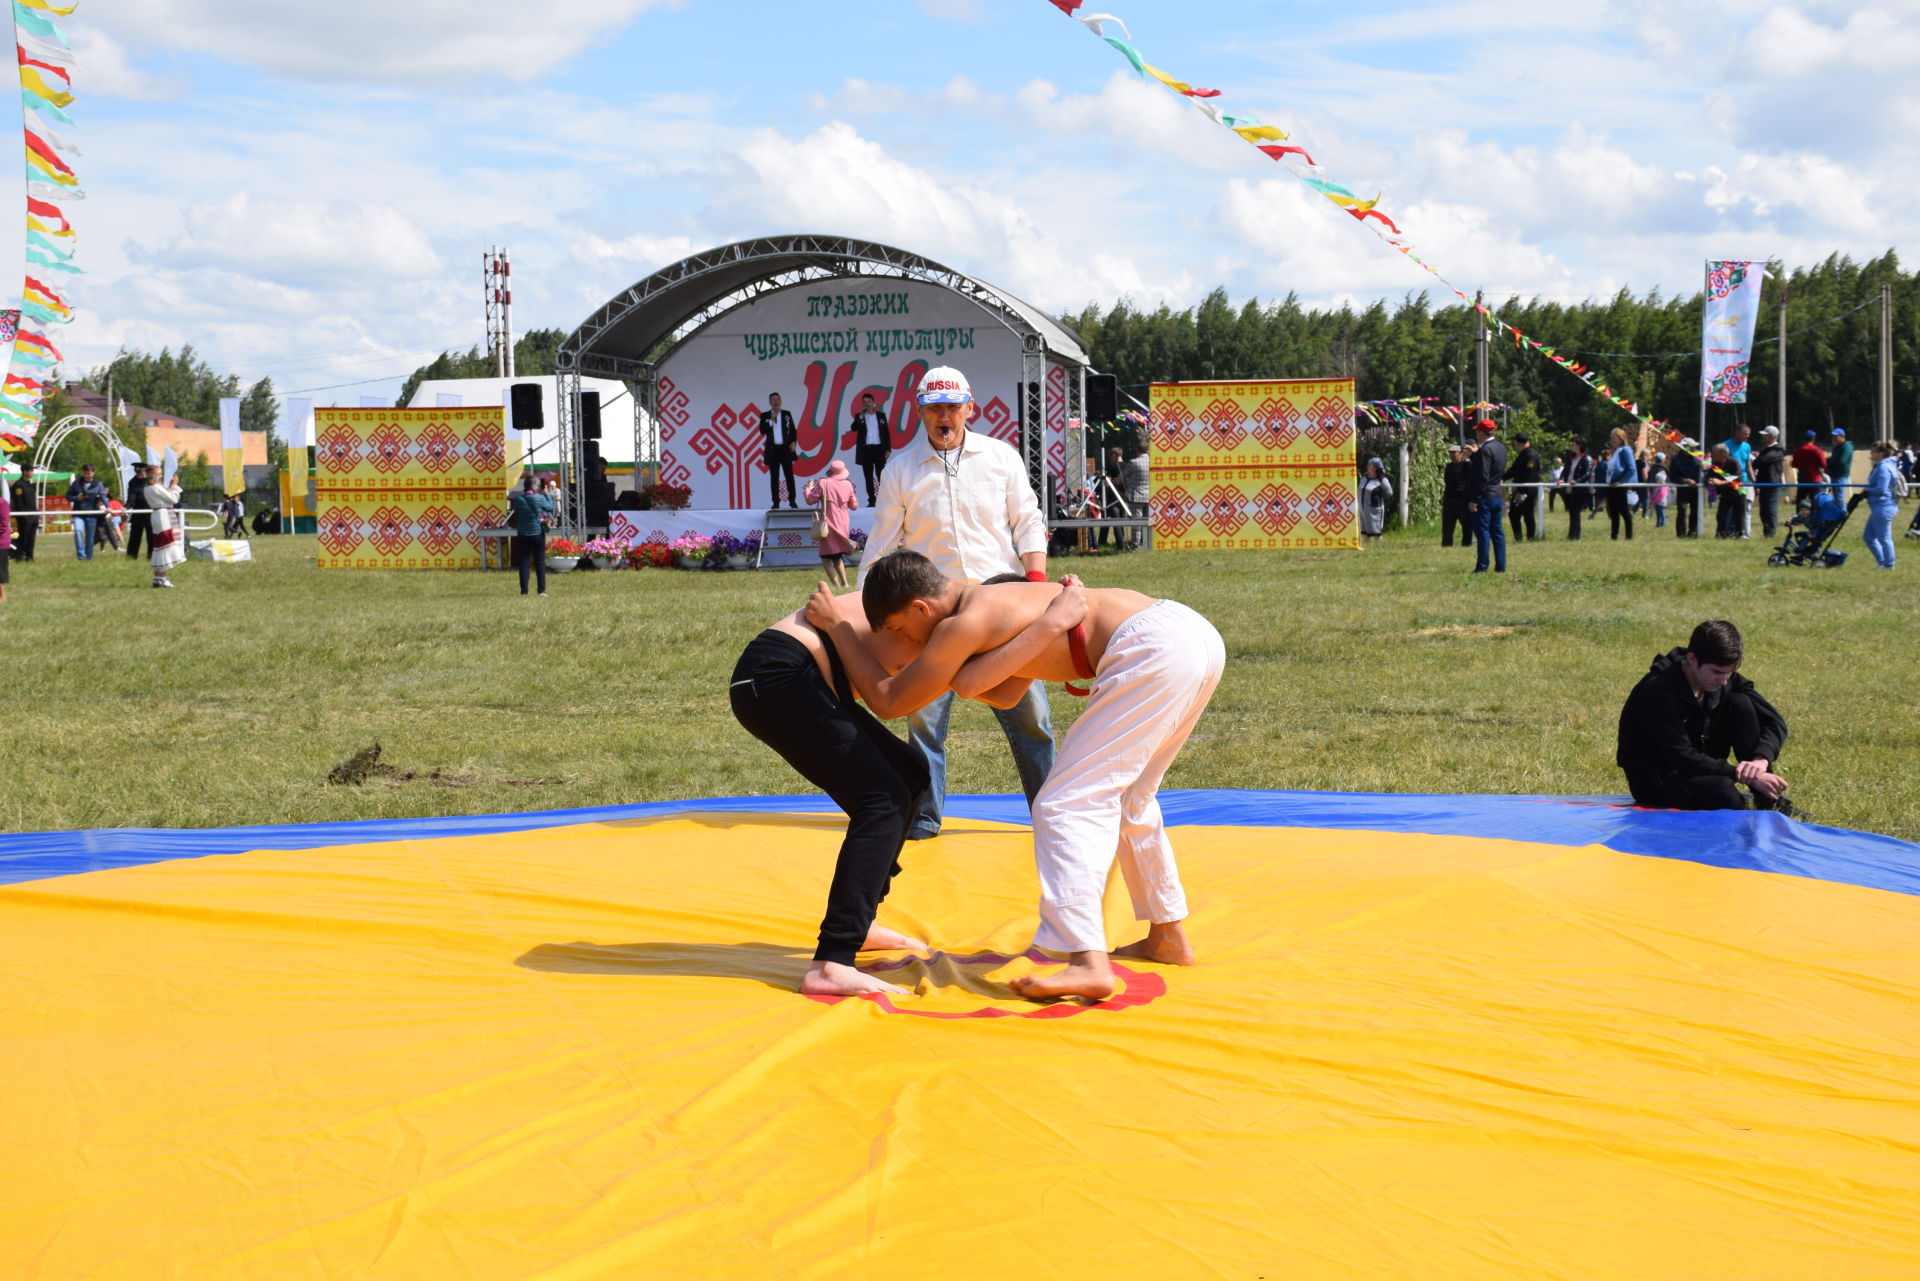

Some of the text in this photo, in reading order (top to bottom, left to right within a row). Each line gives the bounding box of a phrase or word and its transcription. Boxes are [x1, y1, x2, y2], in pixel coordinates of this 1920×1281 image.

[807, 292, 909, 318] ПРАЗДНИК
[744, 327, 974, 360] ЧУВАШСКОЙ КУЛЬТУРЫ
[927, 380, 960, 391] RUSSIA
